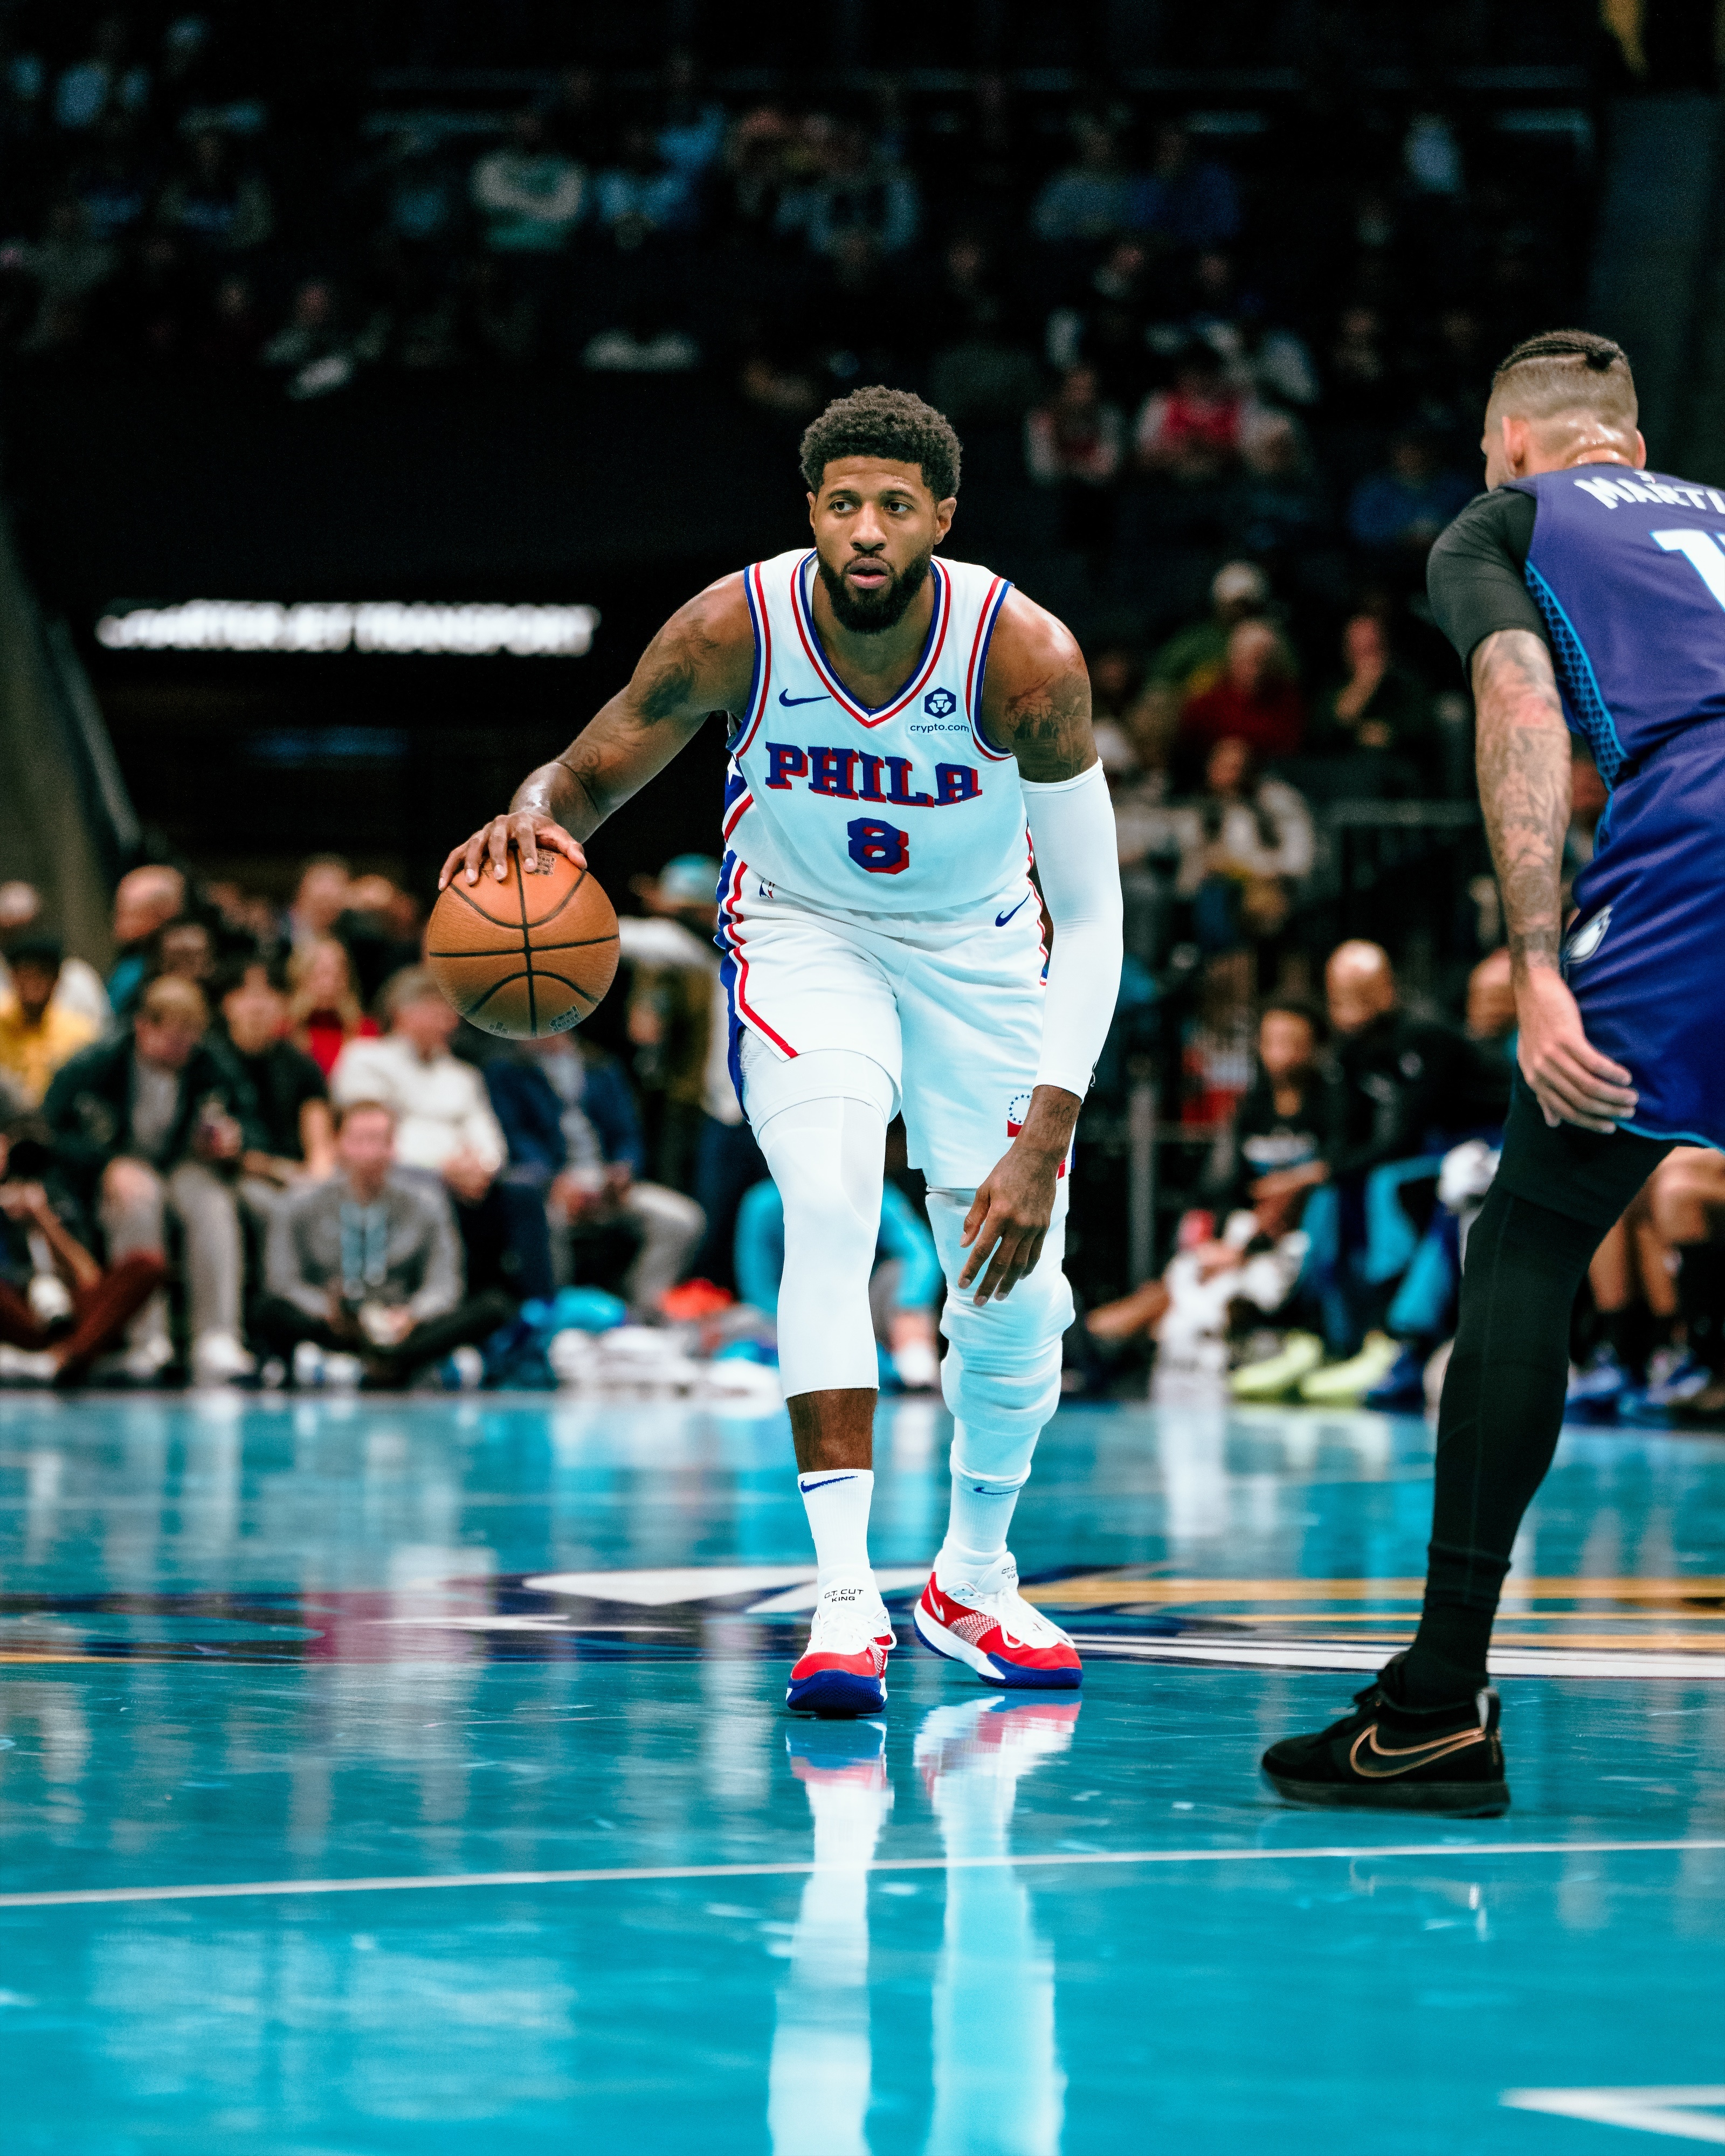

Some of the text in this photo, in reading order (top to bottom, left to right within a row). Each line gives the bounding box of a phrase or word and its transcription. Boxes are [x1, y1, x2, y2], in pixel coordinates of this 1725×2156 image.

[1574, 477, 1725, 514] MARTI
[910, 723, 969, 733] crypto.com
[765, 742, 982, 807] PHILA
[847, 817, 909, 875] 8
[824, 1590, 838, 1599] G.T.
